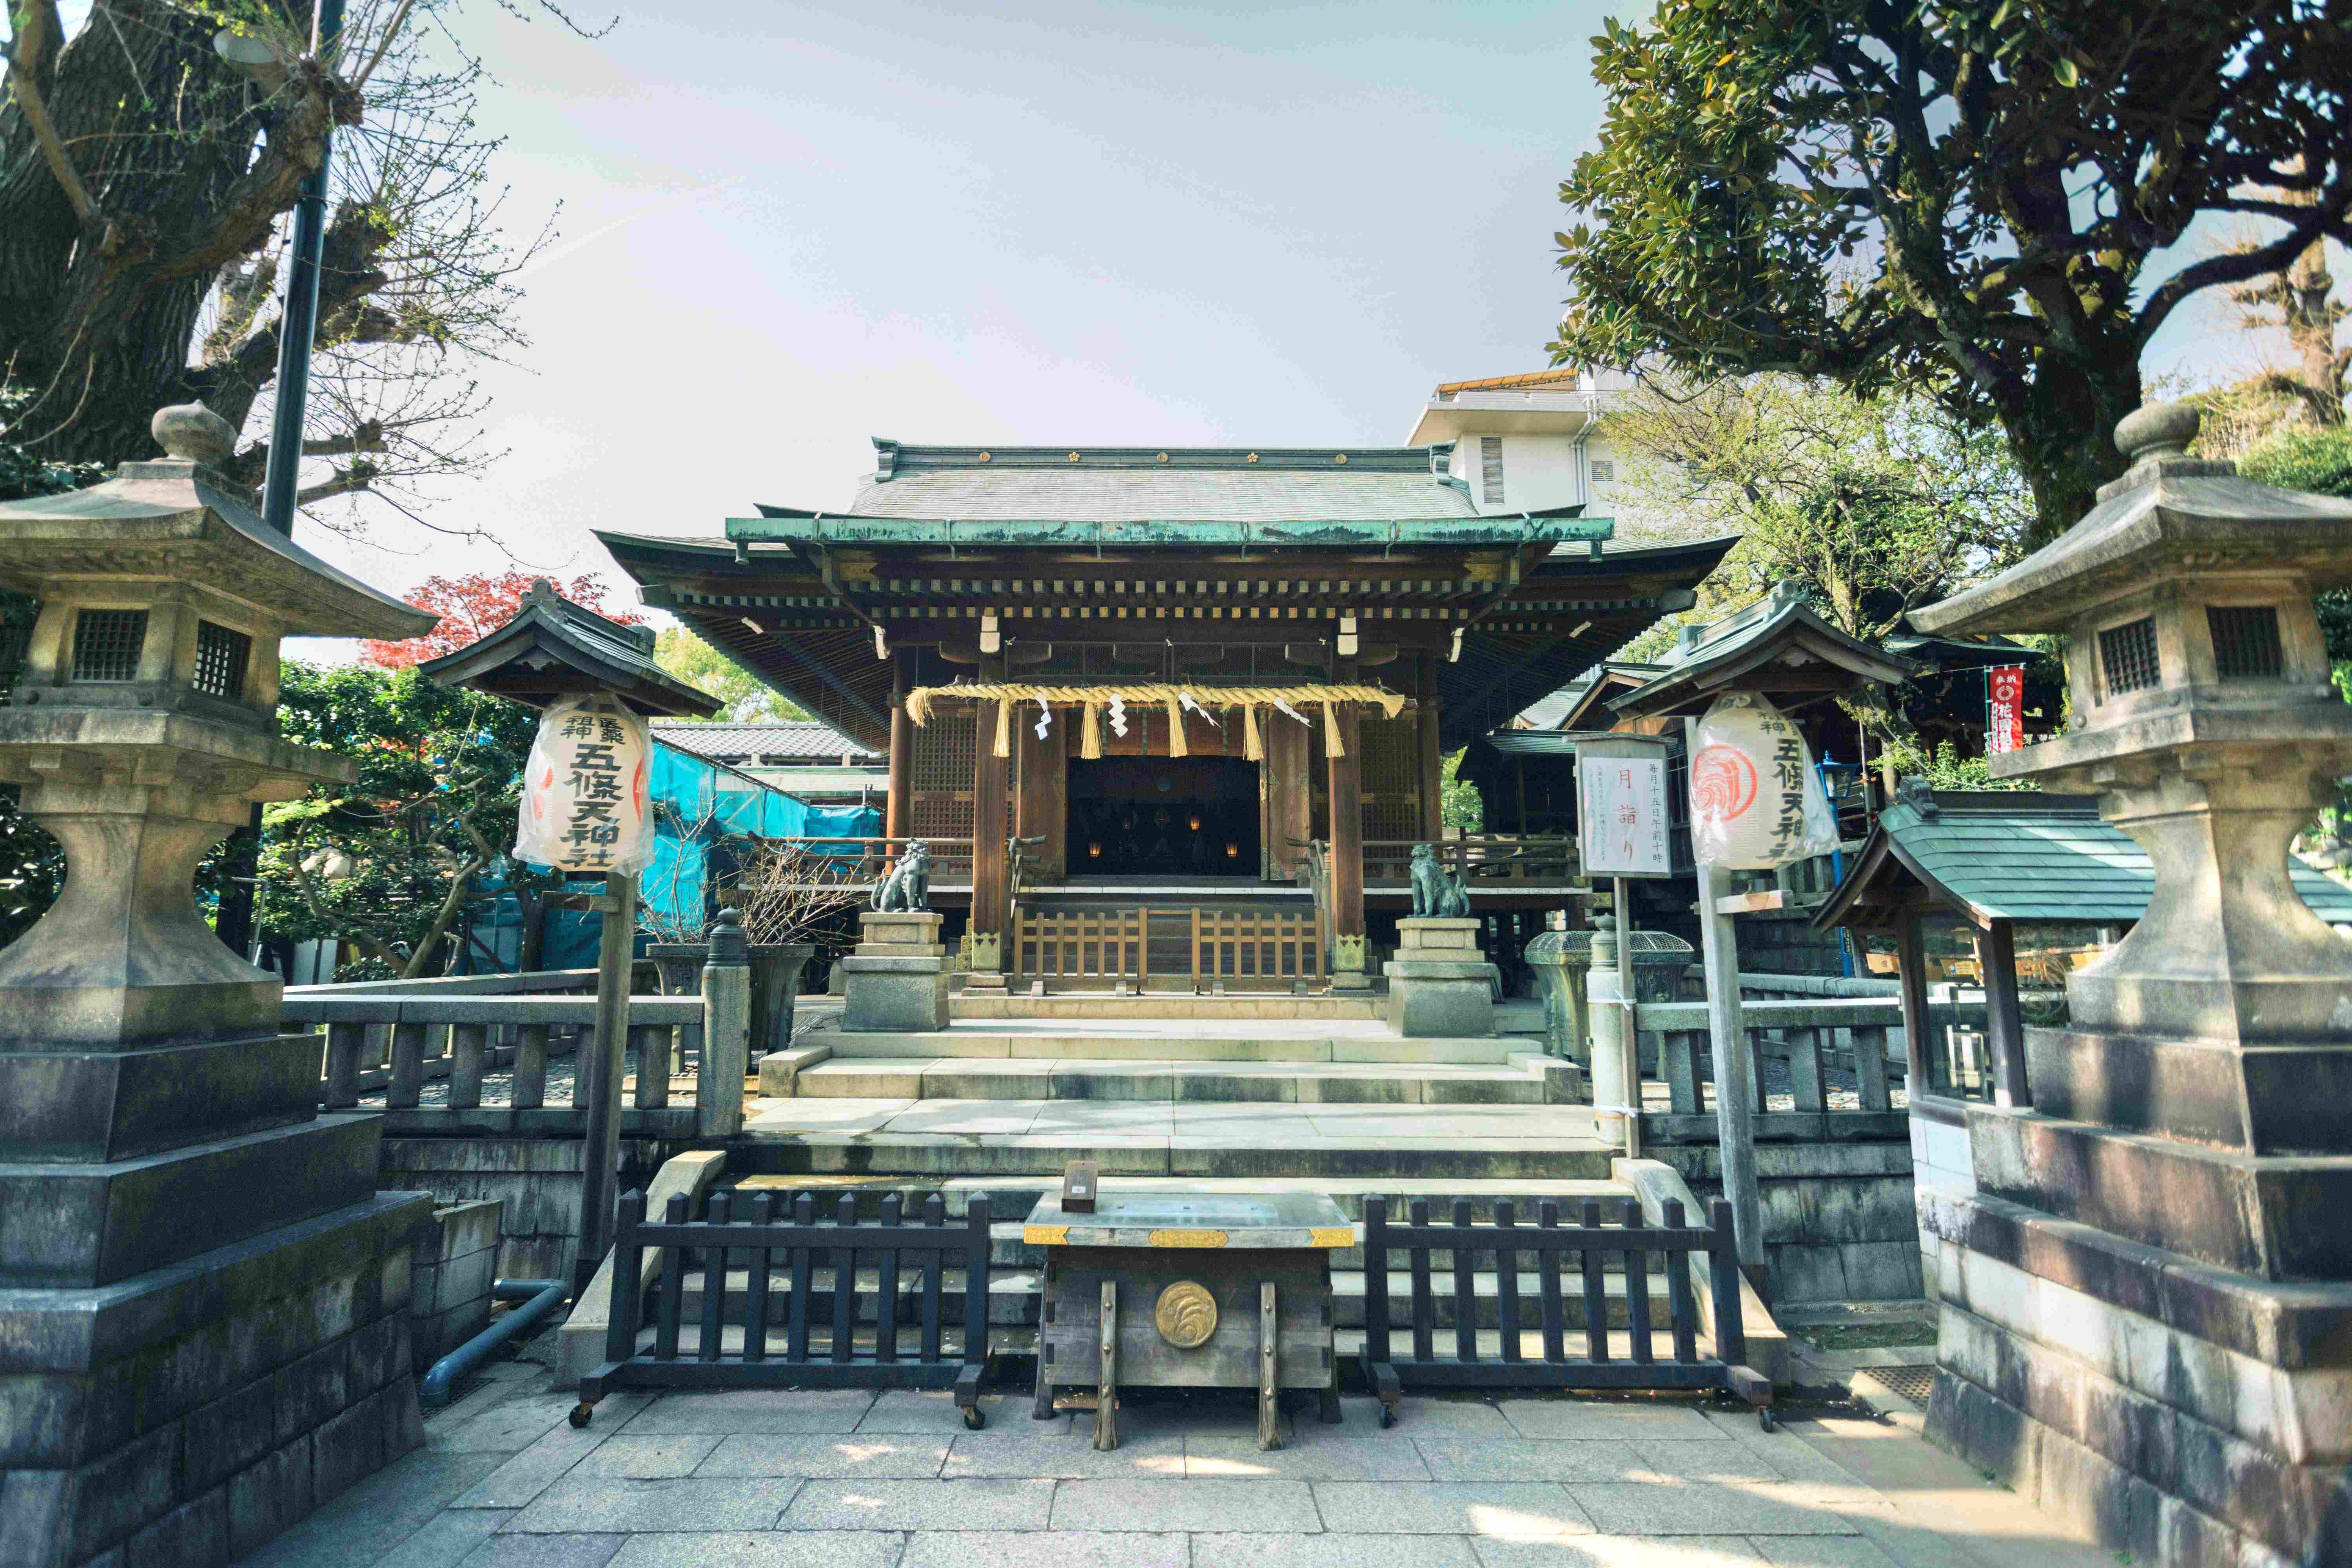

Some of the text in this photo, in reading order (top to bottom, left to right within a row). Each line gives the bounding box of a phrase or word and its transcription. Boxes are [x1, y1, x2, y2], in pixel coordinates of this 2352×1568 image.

[560, 715, 595, 740] 祖神
[599, 717, 626, 745] 医薬
[558, 743, 624, 867] 五條天神社
[1615, 768, 1637, 860] 月詣り
